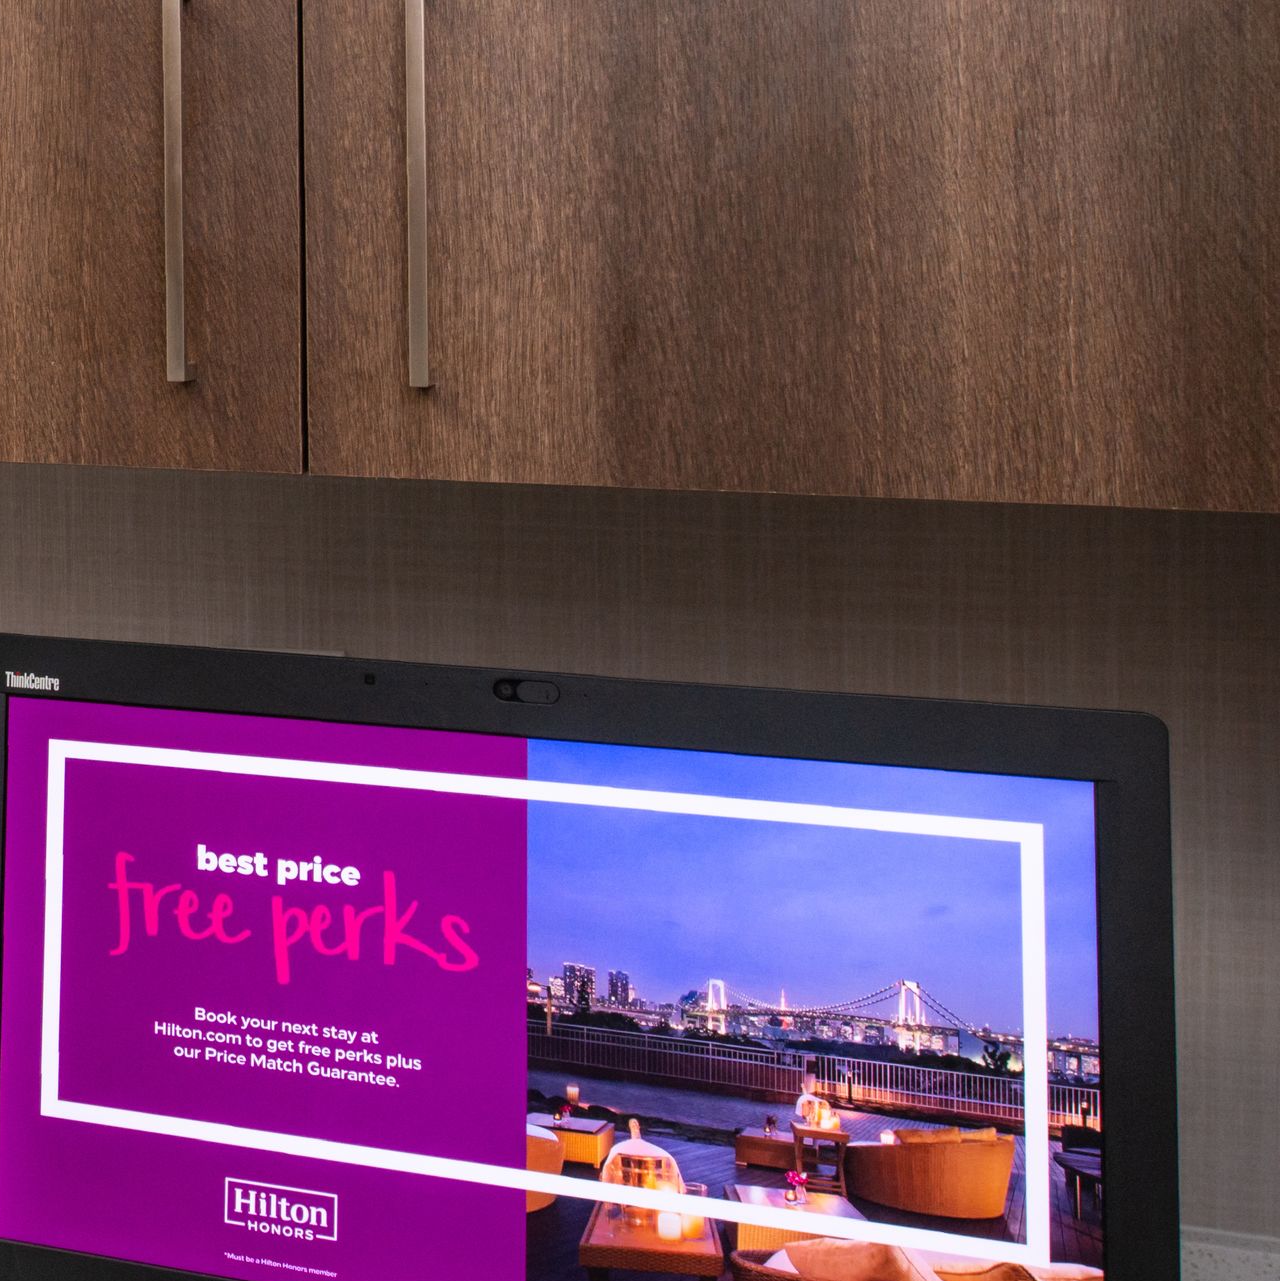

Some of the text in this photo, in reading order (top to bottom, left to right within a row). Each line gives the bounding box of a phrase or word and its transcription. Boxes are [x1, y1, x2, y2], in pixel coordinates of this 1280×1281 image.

[5, 671, 60, 691] ThinkCentre
[196, 843, 361, 886] best price
[107, 851, 480, 985] free perks
[154, 1021, 422, 1071] Hilton.com to get free perks plus
[194, 1007, 379, 1045] Book your next stay at
[173, 1045, 401, 1088] our Price Match Guarantee.
[233, 1187, 328, 1228] Hilton
[247, 1220, 314, 1241] HONORS
[245, 1255, 255, 1263] be
[261, 1258, 282, 1268] Hilton
[282, 1262, 308, 1273] Honors
[308, 1267, 338, 1278] member
